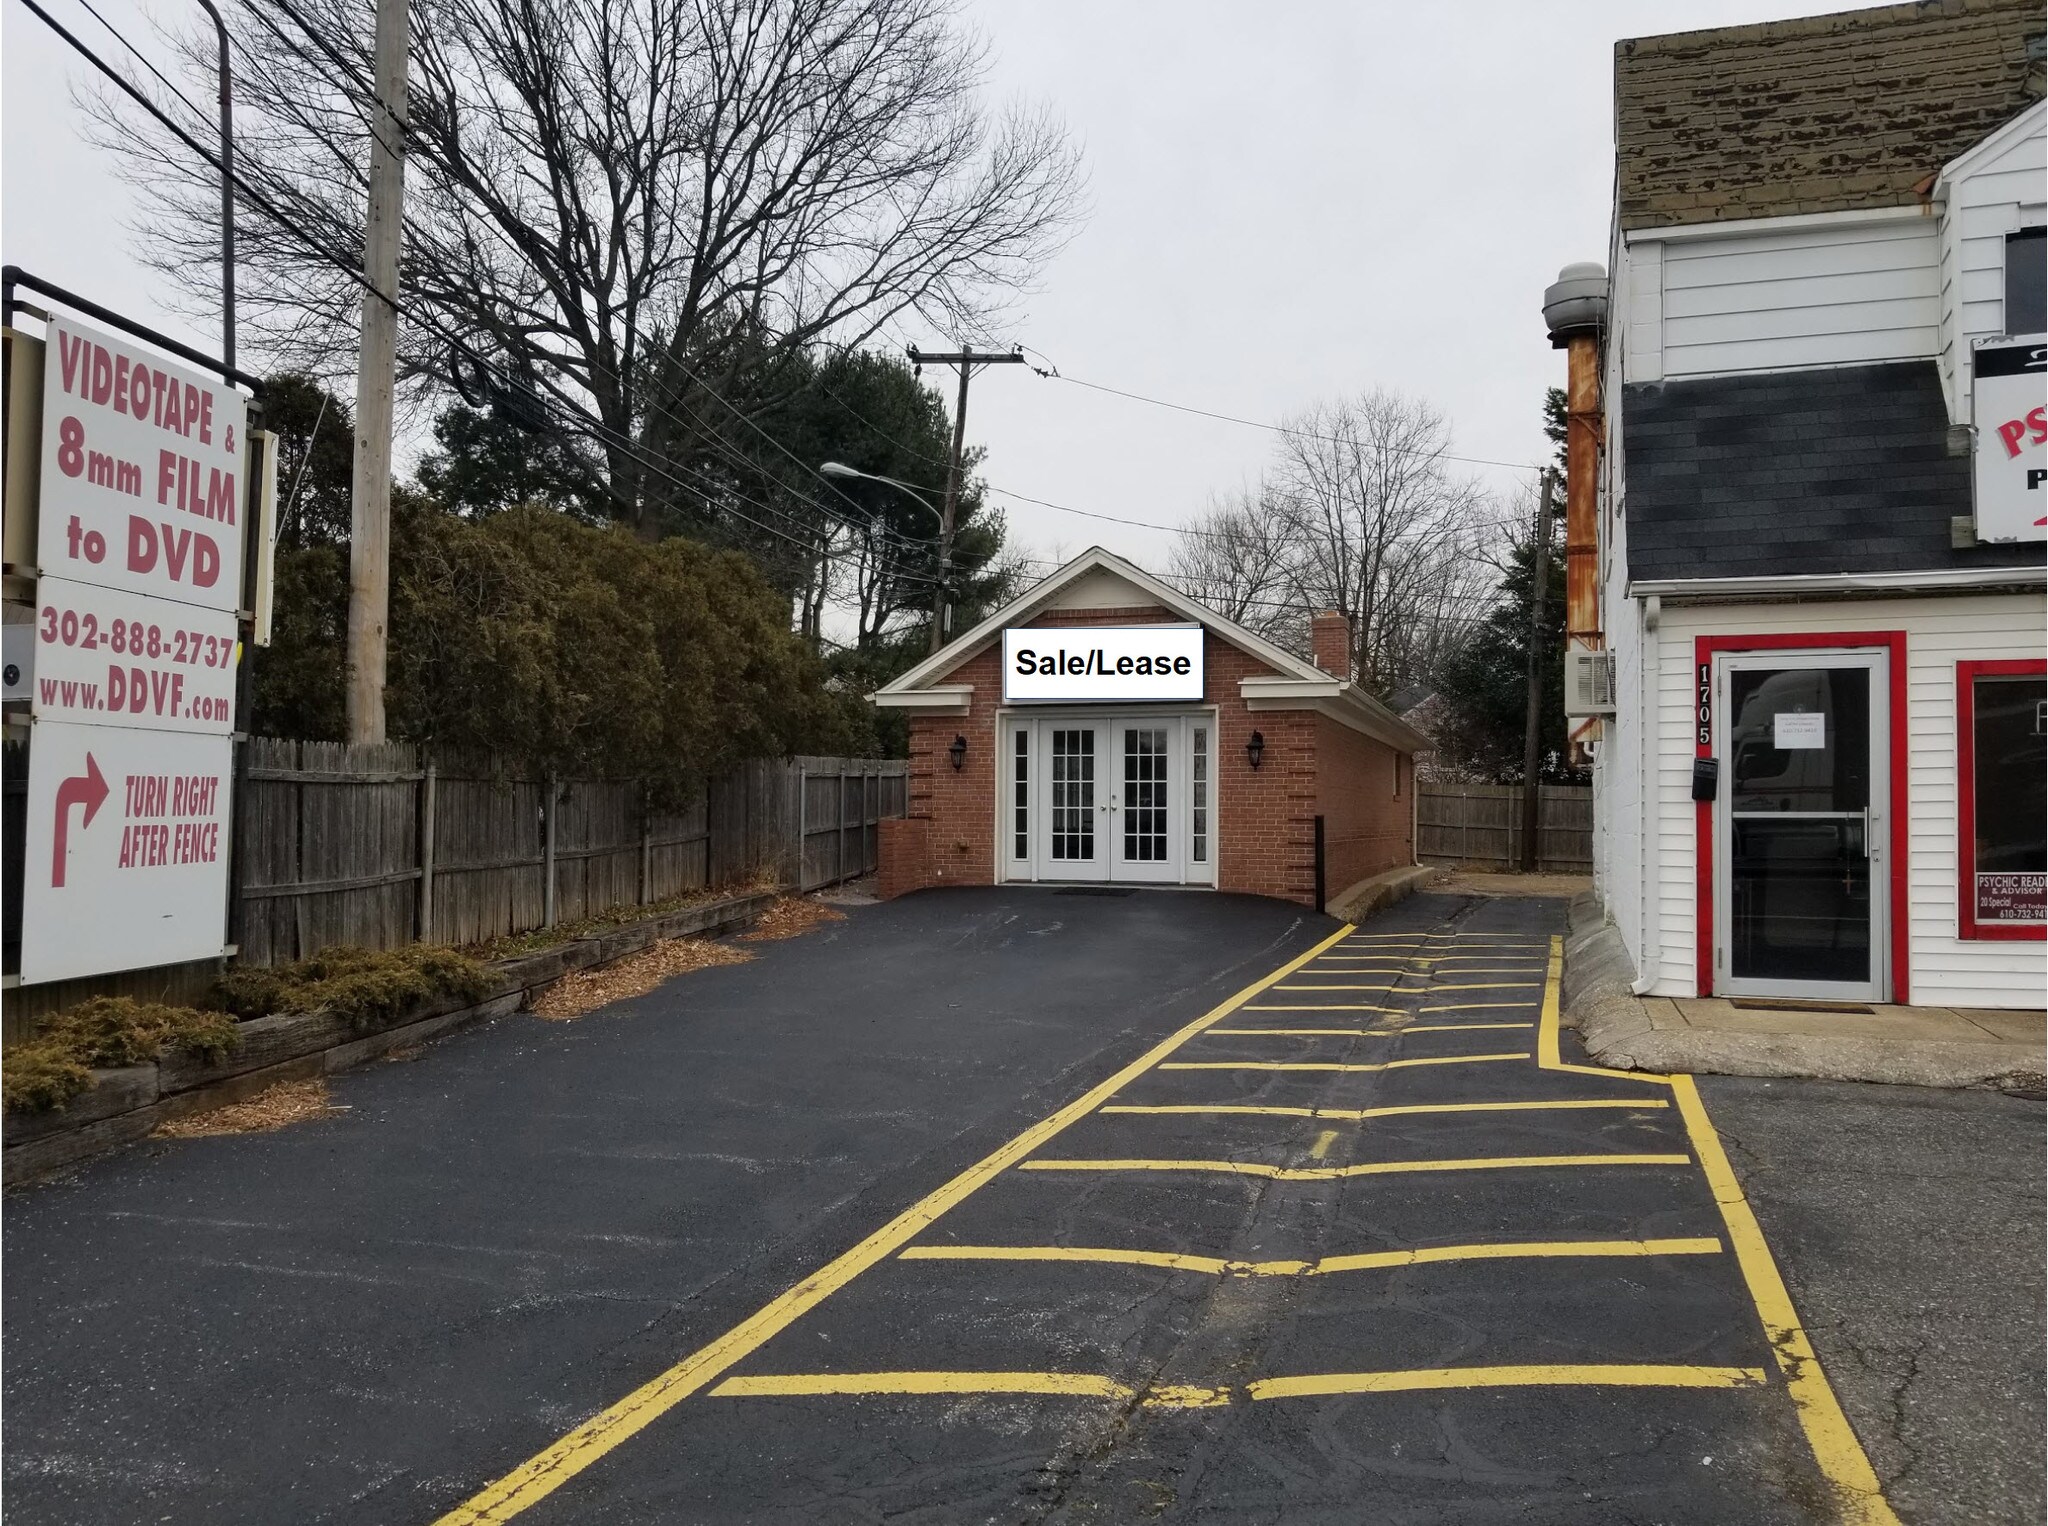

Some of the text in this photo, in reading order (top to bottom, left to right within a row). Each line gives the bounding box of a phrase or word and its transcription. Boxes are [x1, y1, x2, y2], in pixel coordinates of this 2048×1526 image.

[58, 328, 235, 455] VIDEOTAPE &
[57, 415, 236, 527] 8mm FILM
[67, 513, 221, 589] to DVD
[40, 605, 234, 670] 302-888-2737
[39, 664, 229, 723] www.DDVF.com
[1699, 665, 1711, 744] 1705
[124, 775, 219, 818] TURN RIGHT
[118, 822, 219, 869] AFTER FENCE
[1979, 876, 2018, 888] PSYCHIC
[1989, 896, 2012, 909] Special
[1992, 887, 2043, 895] & ADVISOR
